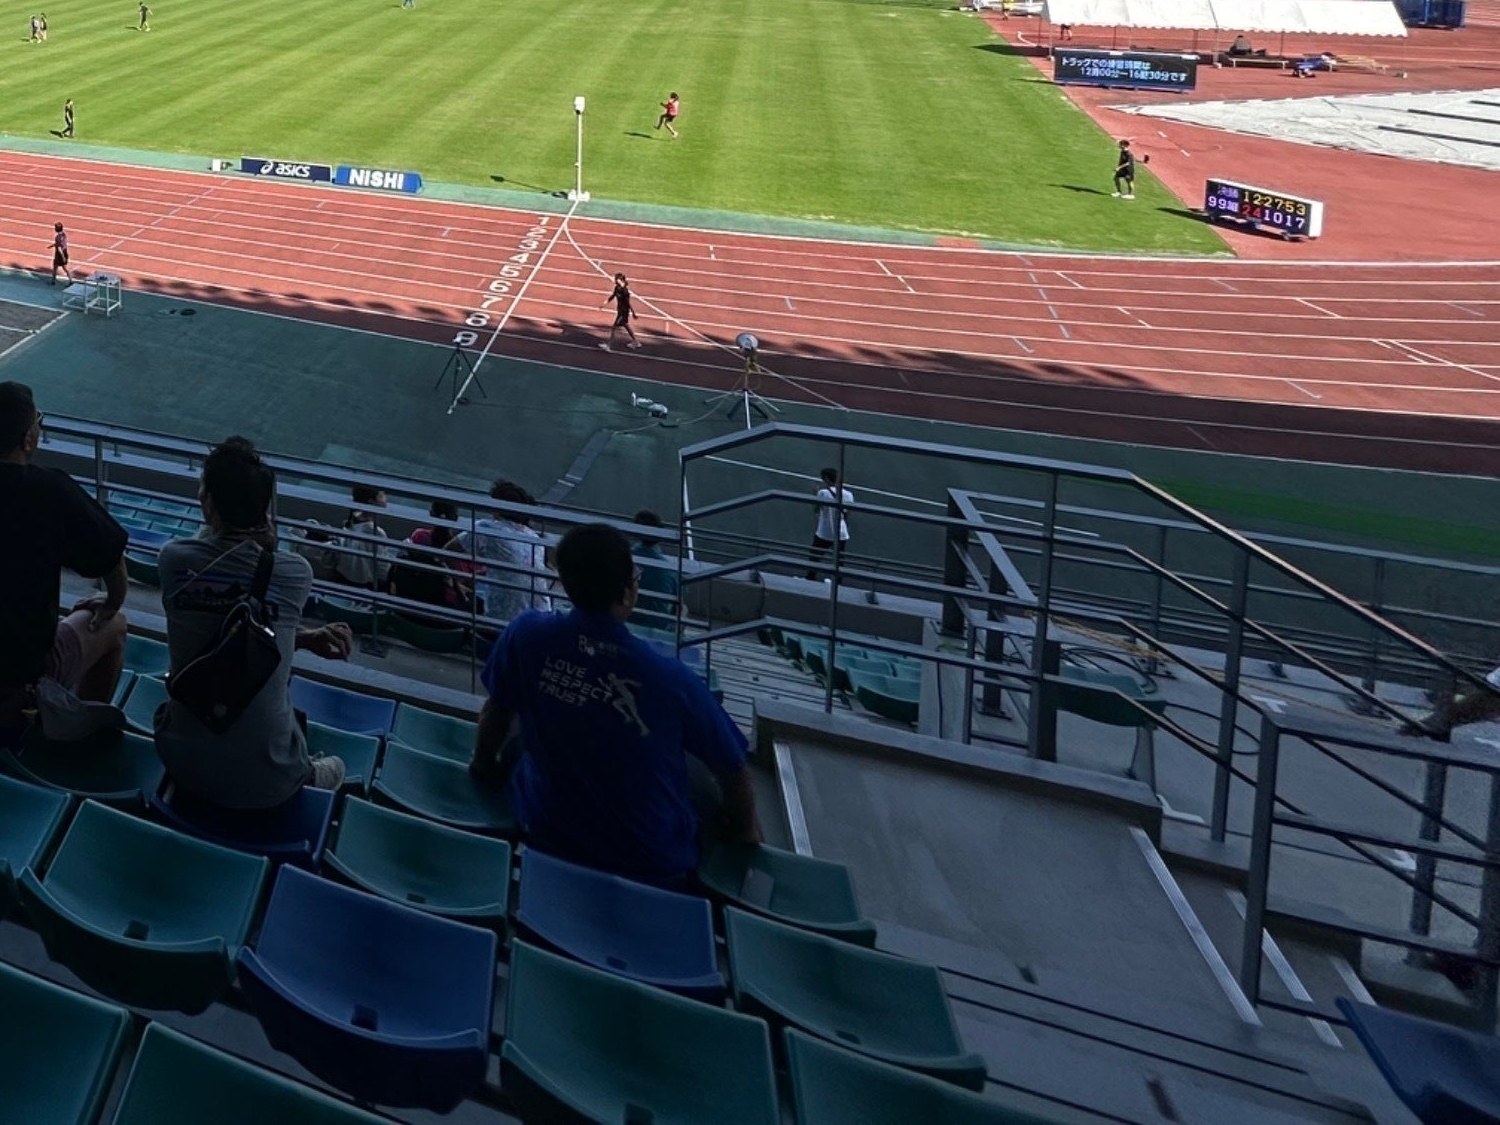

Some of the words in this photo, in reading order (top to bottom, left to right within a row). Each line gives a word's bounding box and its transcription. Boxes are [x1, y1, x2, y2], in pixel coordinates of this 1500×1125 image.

[275, 162, 310, 177] asics
[348, 169, 404, 189] NISHI
[538, 216, 550, 225] 1
[526, 226, 547, 237] 2
[518, 239, 539, 250] 3
[509, 253, 530, 264] 4
[500, 265, 522, 277] 5
[489, 280, 512, 292] 6
[481, 295, 503, 309] 7
[465, 312, 490, 327] 8
[544, 655, 588, 678] LOVE
[540, 668, 613, 703] RESPECT
[538, 680, 588, 707] TRUST
